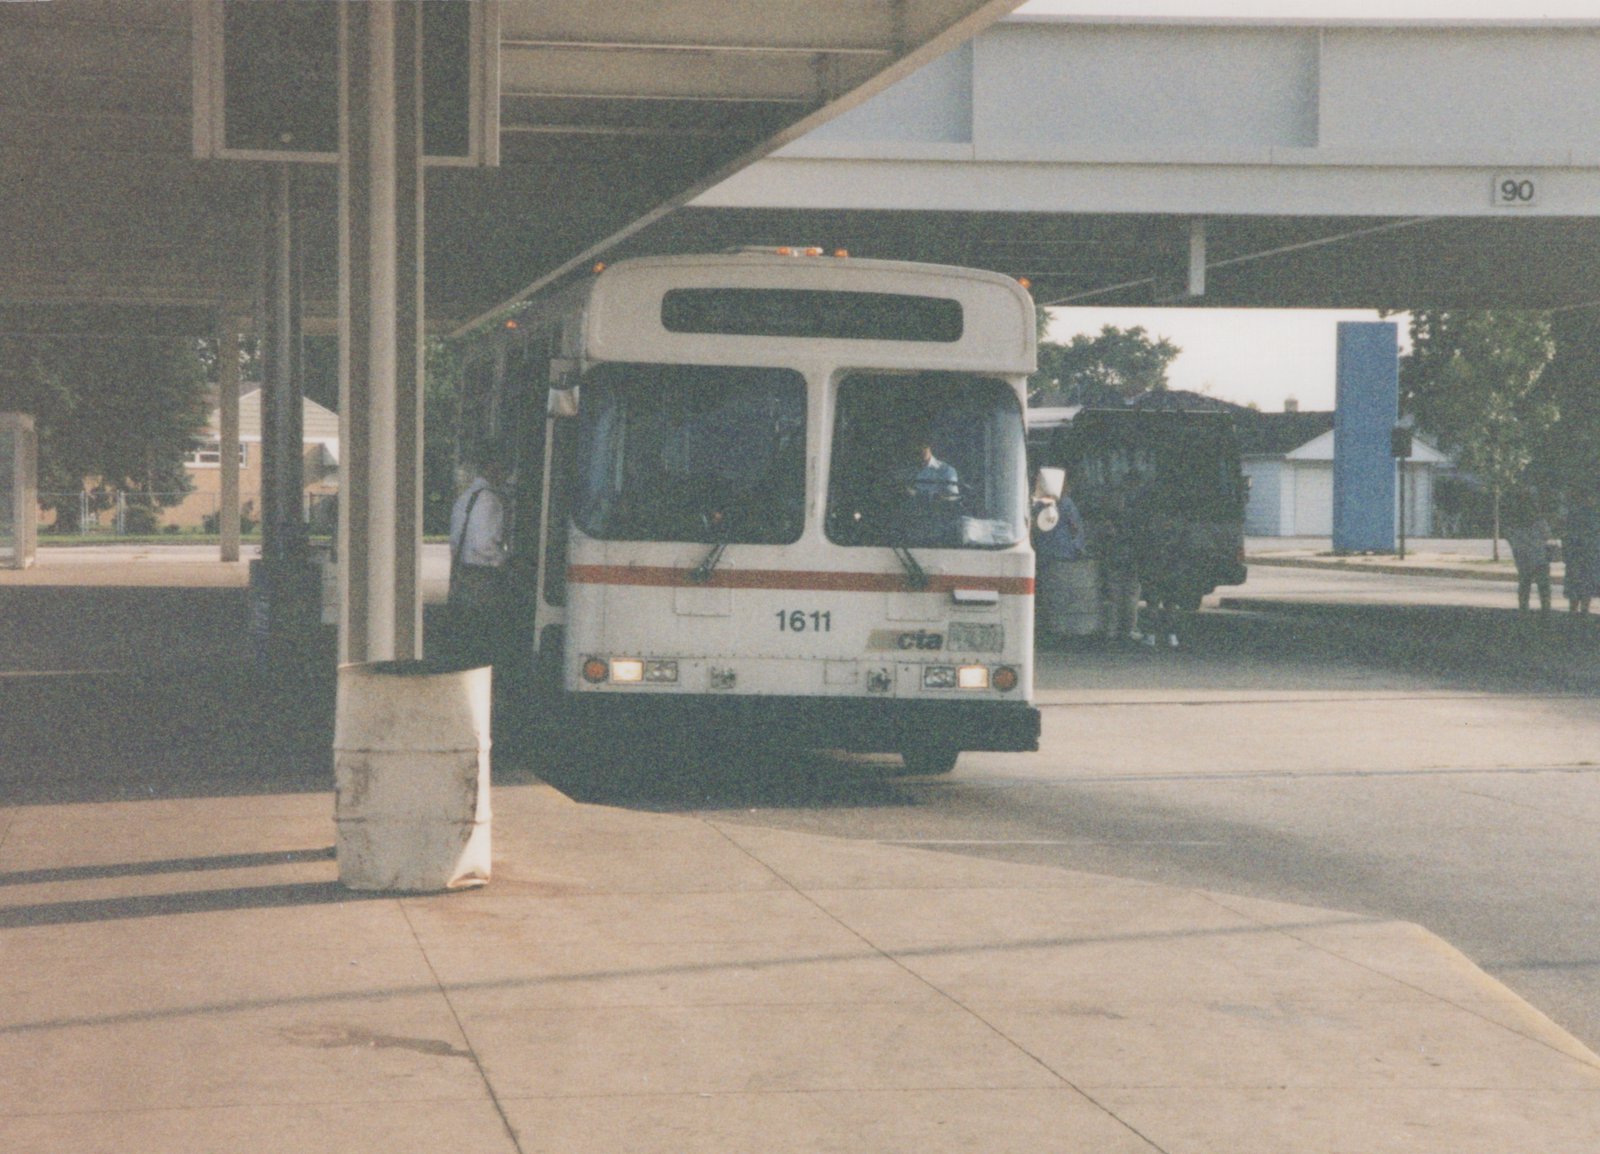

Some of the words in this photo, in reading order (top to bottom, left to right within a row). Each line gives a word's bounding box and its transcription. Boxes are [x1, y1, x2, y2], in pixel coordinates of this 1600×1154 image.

[1501, 179, 1534, 201] 90
[775, 609, 831, 632] 1611
[897, 629, 943, 650] cta
